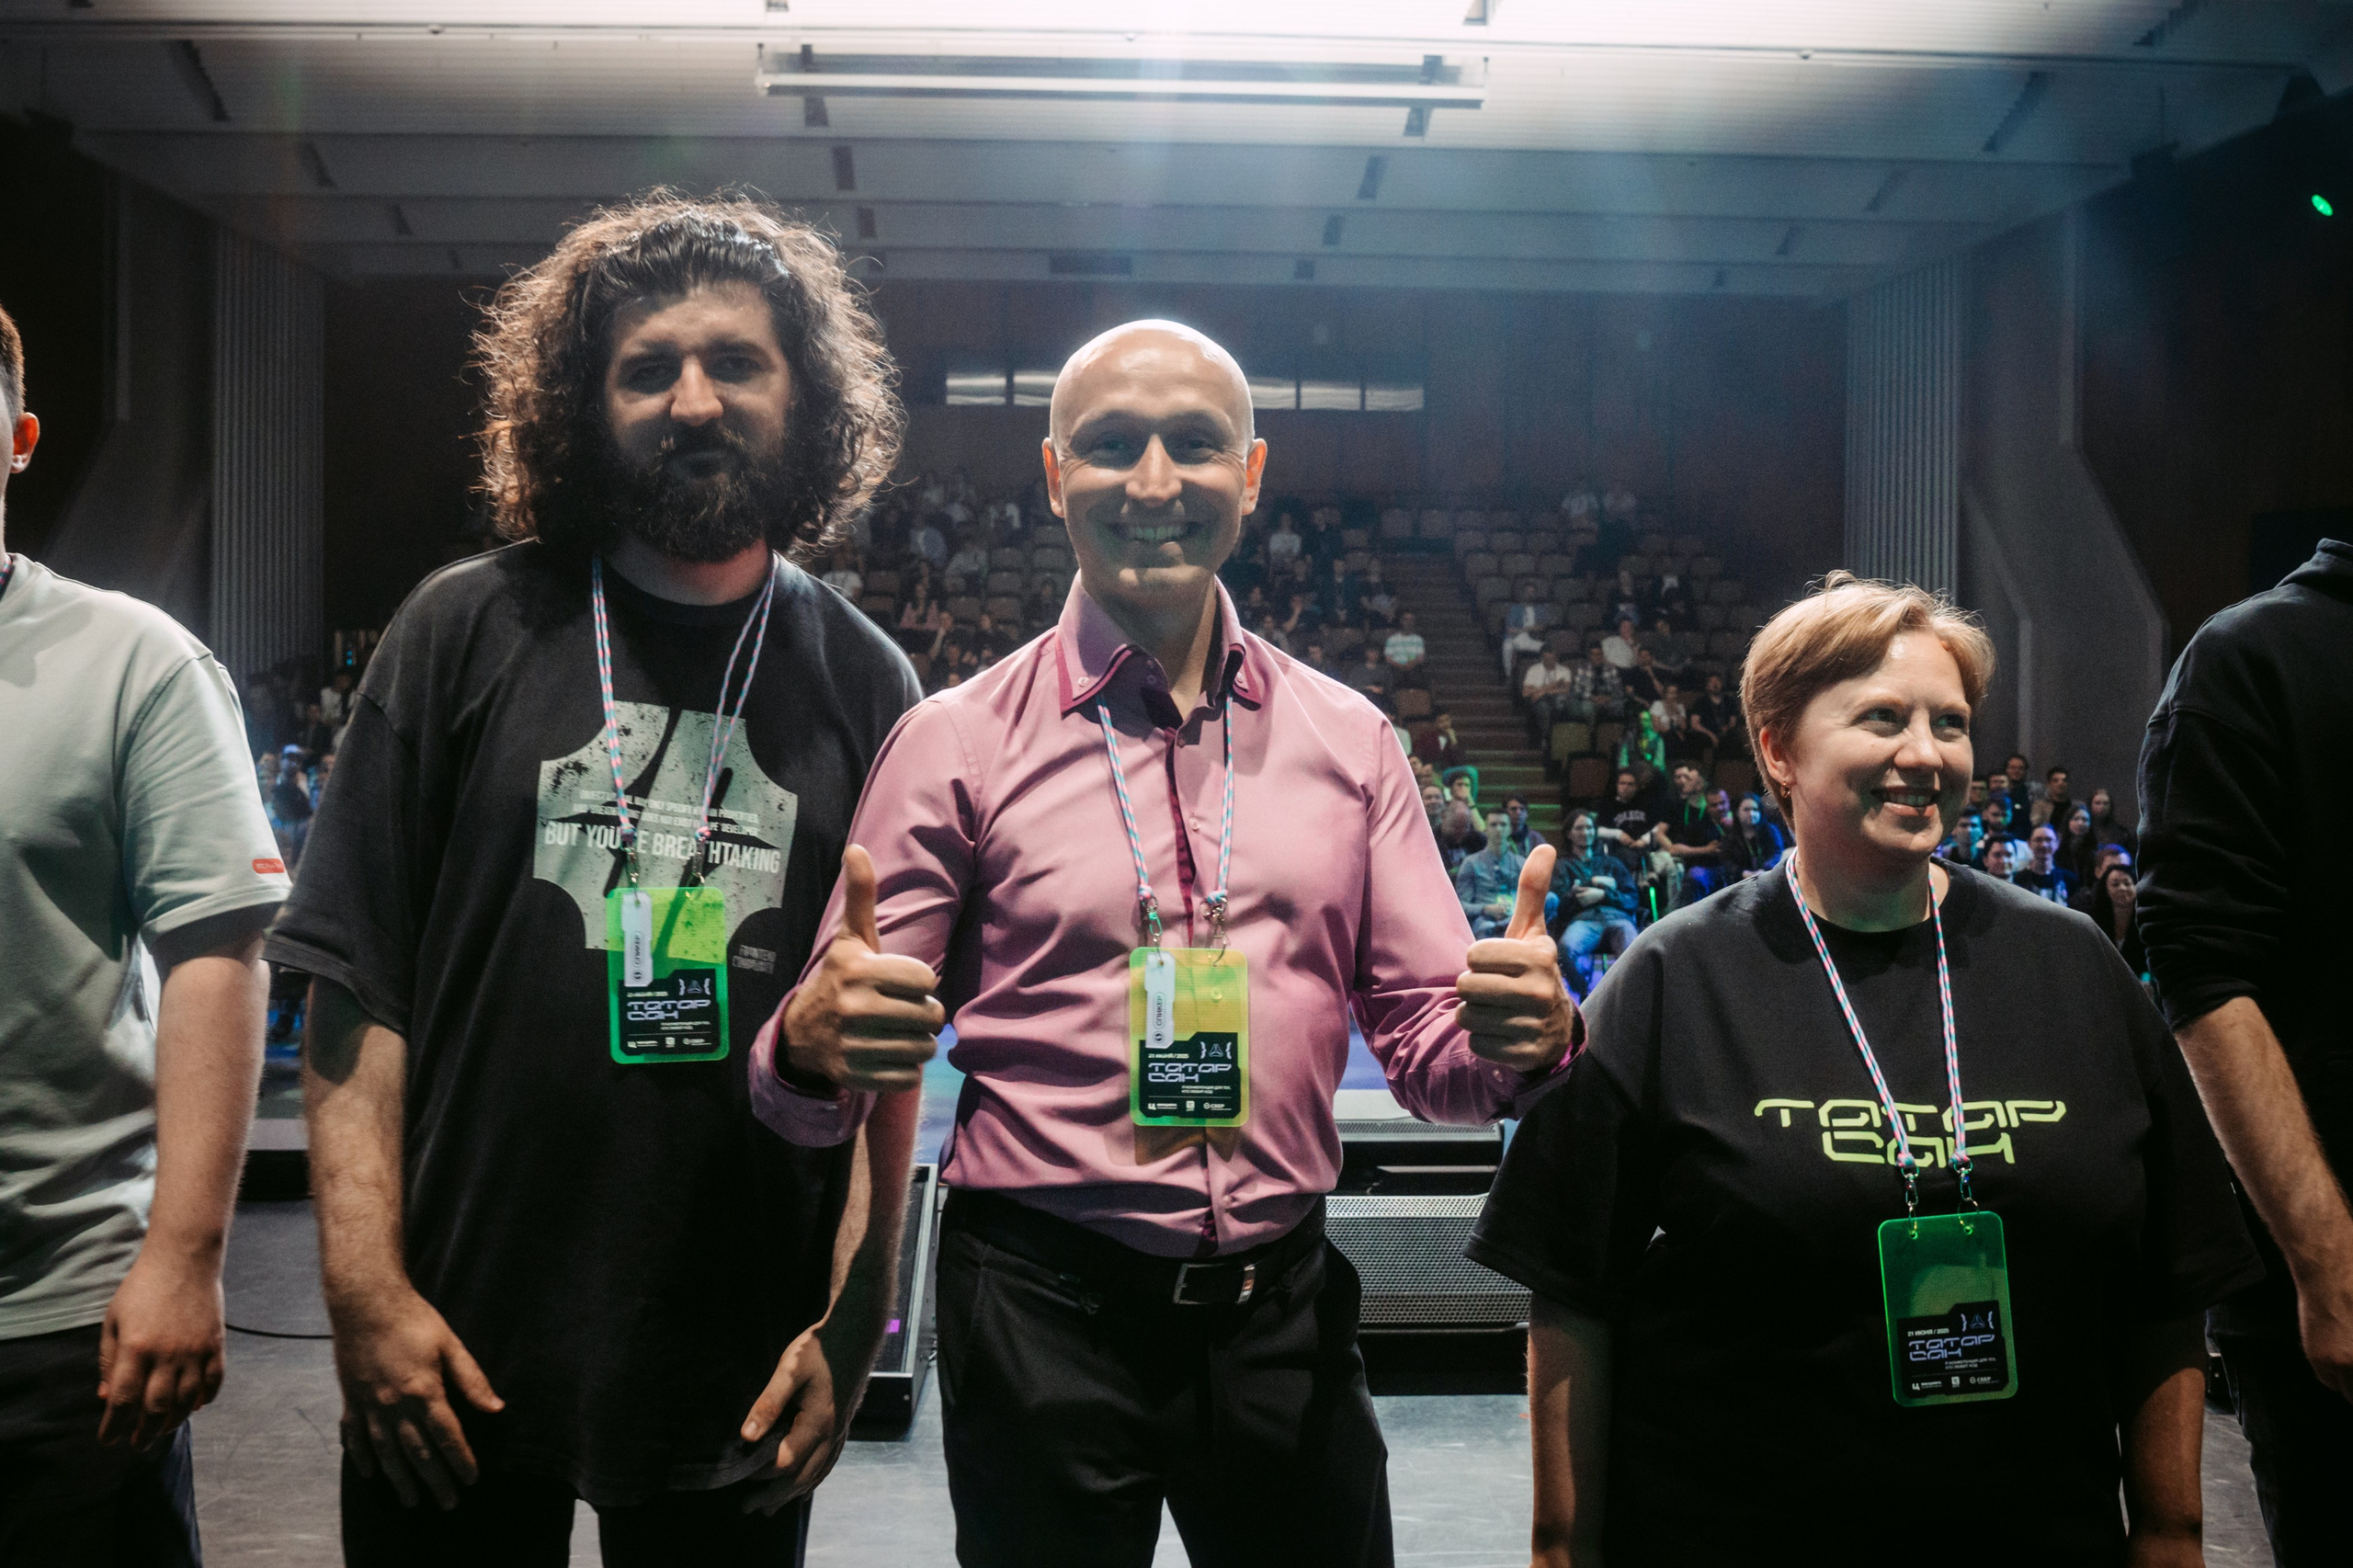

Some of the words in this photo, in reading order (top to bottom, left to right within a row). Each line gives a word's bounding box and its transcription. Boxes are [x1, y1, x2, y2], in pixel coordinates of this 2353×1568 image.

[544, 820, 581, 846] BUT
[585, 824, 649, 854] YOUE
[652, 831, 780, 873] BREAHTAKING
